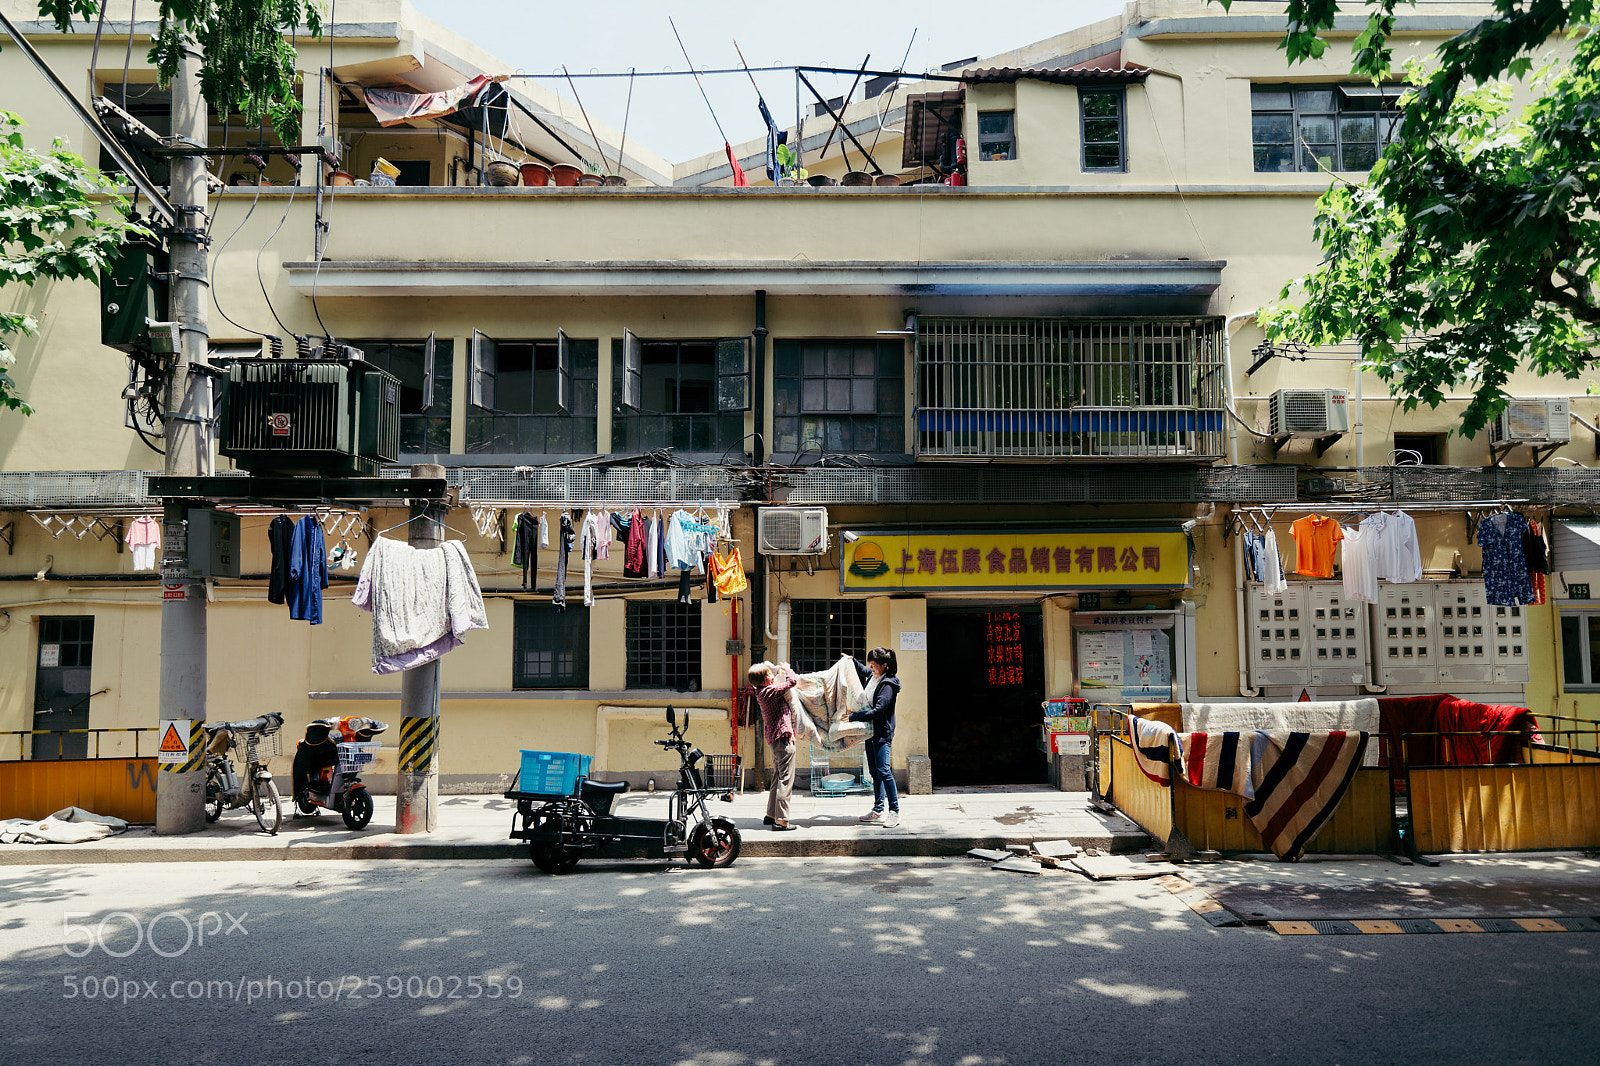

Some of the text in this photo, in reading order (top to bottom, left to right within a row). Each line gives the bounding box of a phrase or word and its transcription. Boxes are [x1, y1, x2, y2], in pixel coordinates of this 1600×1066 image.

[895, 546, 1161, 575] 上海伍康食品销售有限公司
[1571, 585, 1588, 595] 435
[1081, 594, 1098, 603] 435
